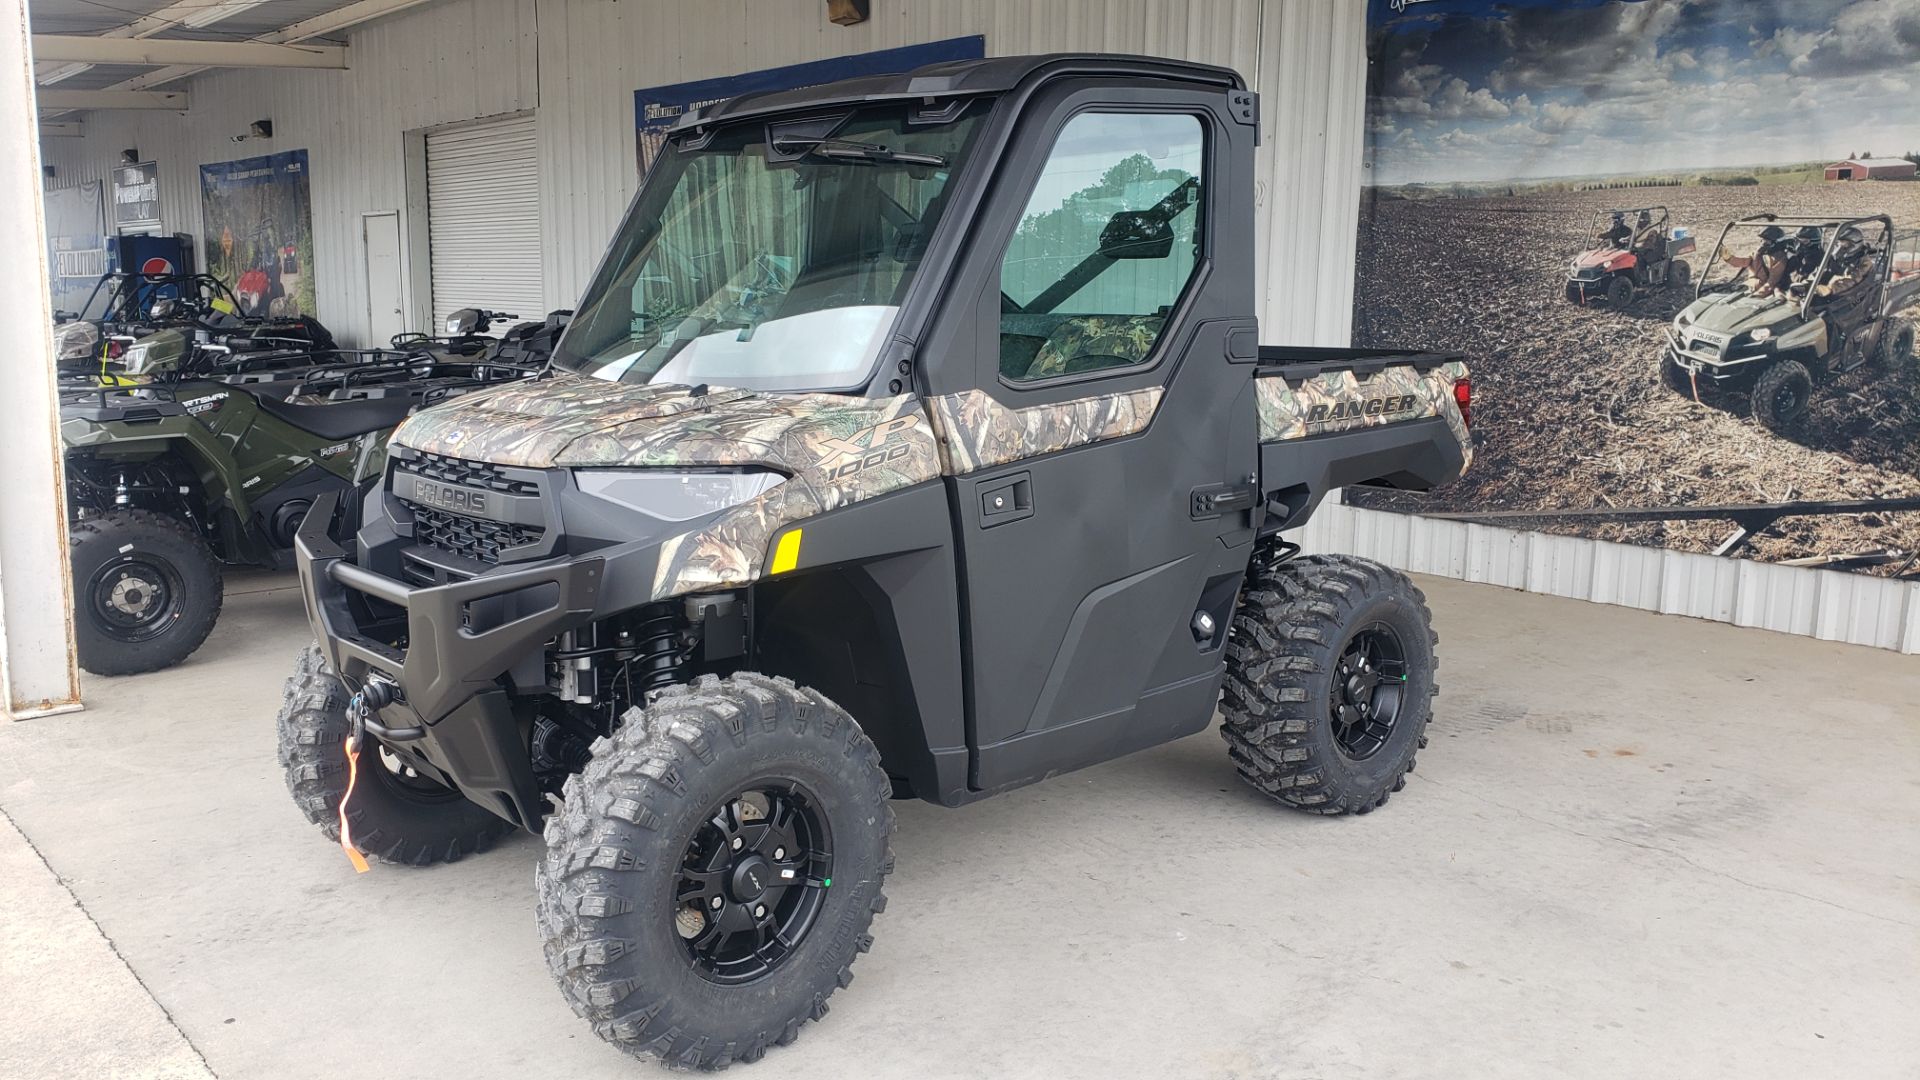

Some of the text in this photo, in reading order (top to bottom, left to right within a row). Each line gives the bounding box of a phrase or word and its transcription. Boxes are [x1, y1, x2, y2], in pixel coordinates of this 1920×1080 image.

[1306, 394, 1418, 424] RANGER
[813, 414, 920, 467] XP
[827, 442, 912, 483] 1000
[415, 480, 486, 513] POLARIS
